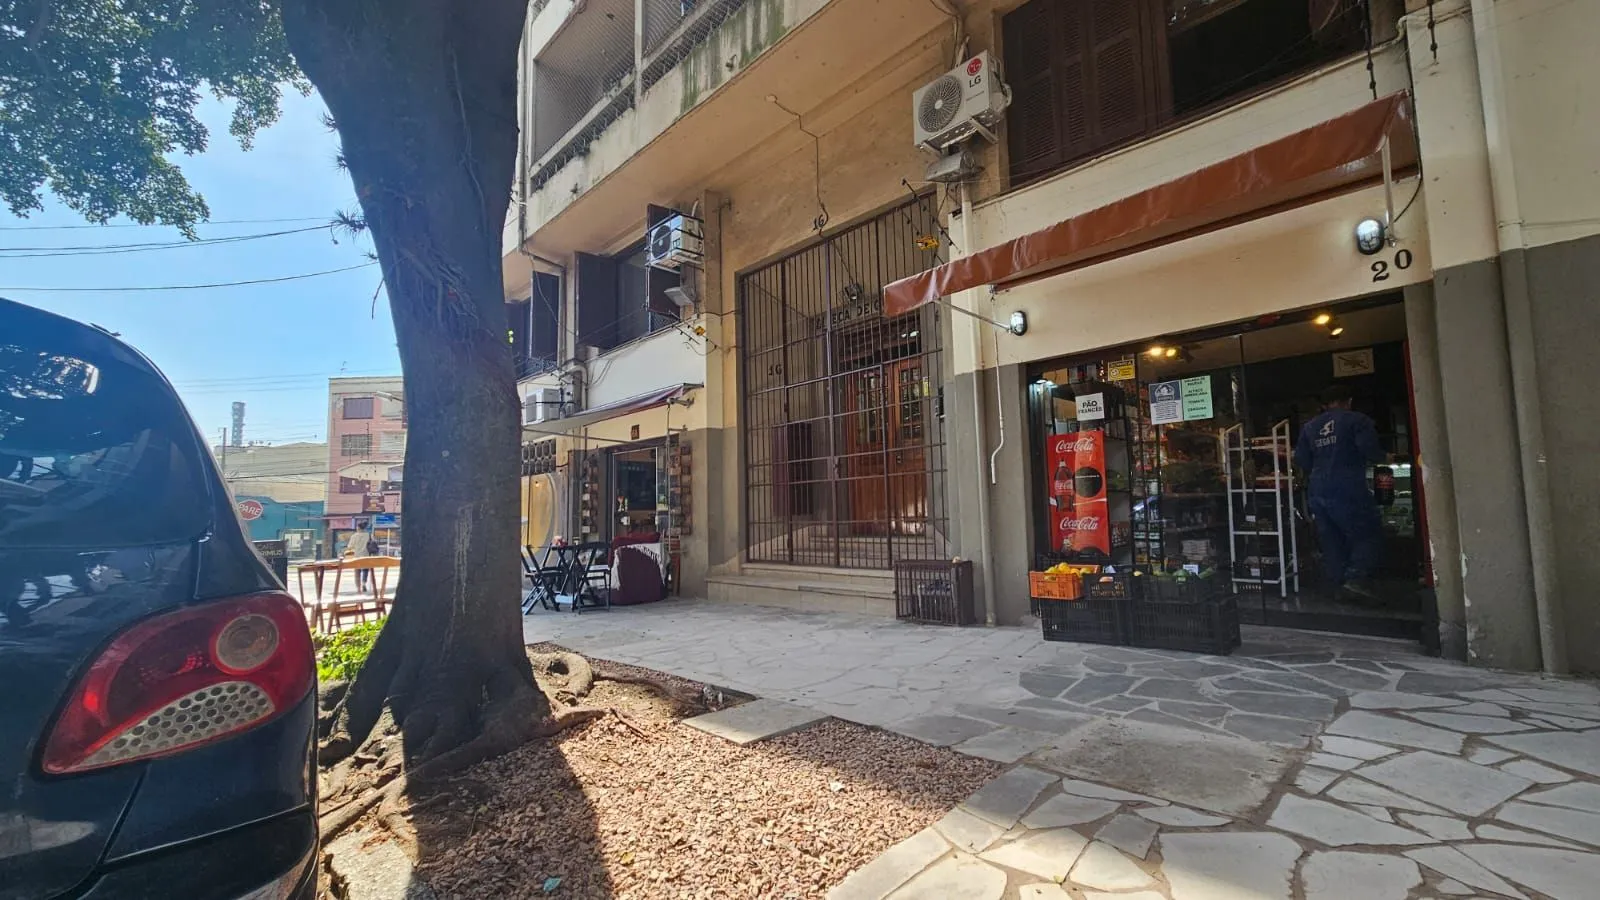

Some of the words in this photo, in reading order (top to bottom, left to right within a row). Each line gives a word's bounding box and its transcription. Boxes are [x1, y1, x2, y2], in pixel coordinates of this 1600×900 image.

[969, 75, 982, 88] LG
[812, 214, 825, 231] 16
[1371, 249, 1412, 282] 20
[1082, 400, 1098, 408] PÃO
[1056, 437, 1095, 453] Coca-Cola
[239, 503, 261, 515] PARE
[1060, 516, 1099, 530] Coca-Cola
